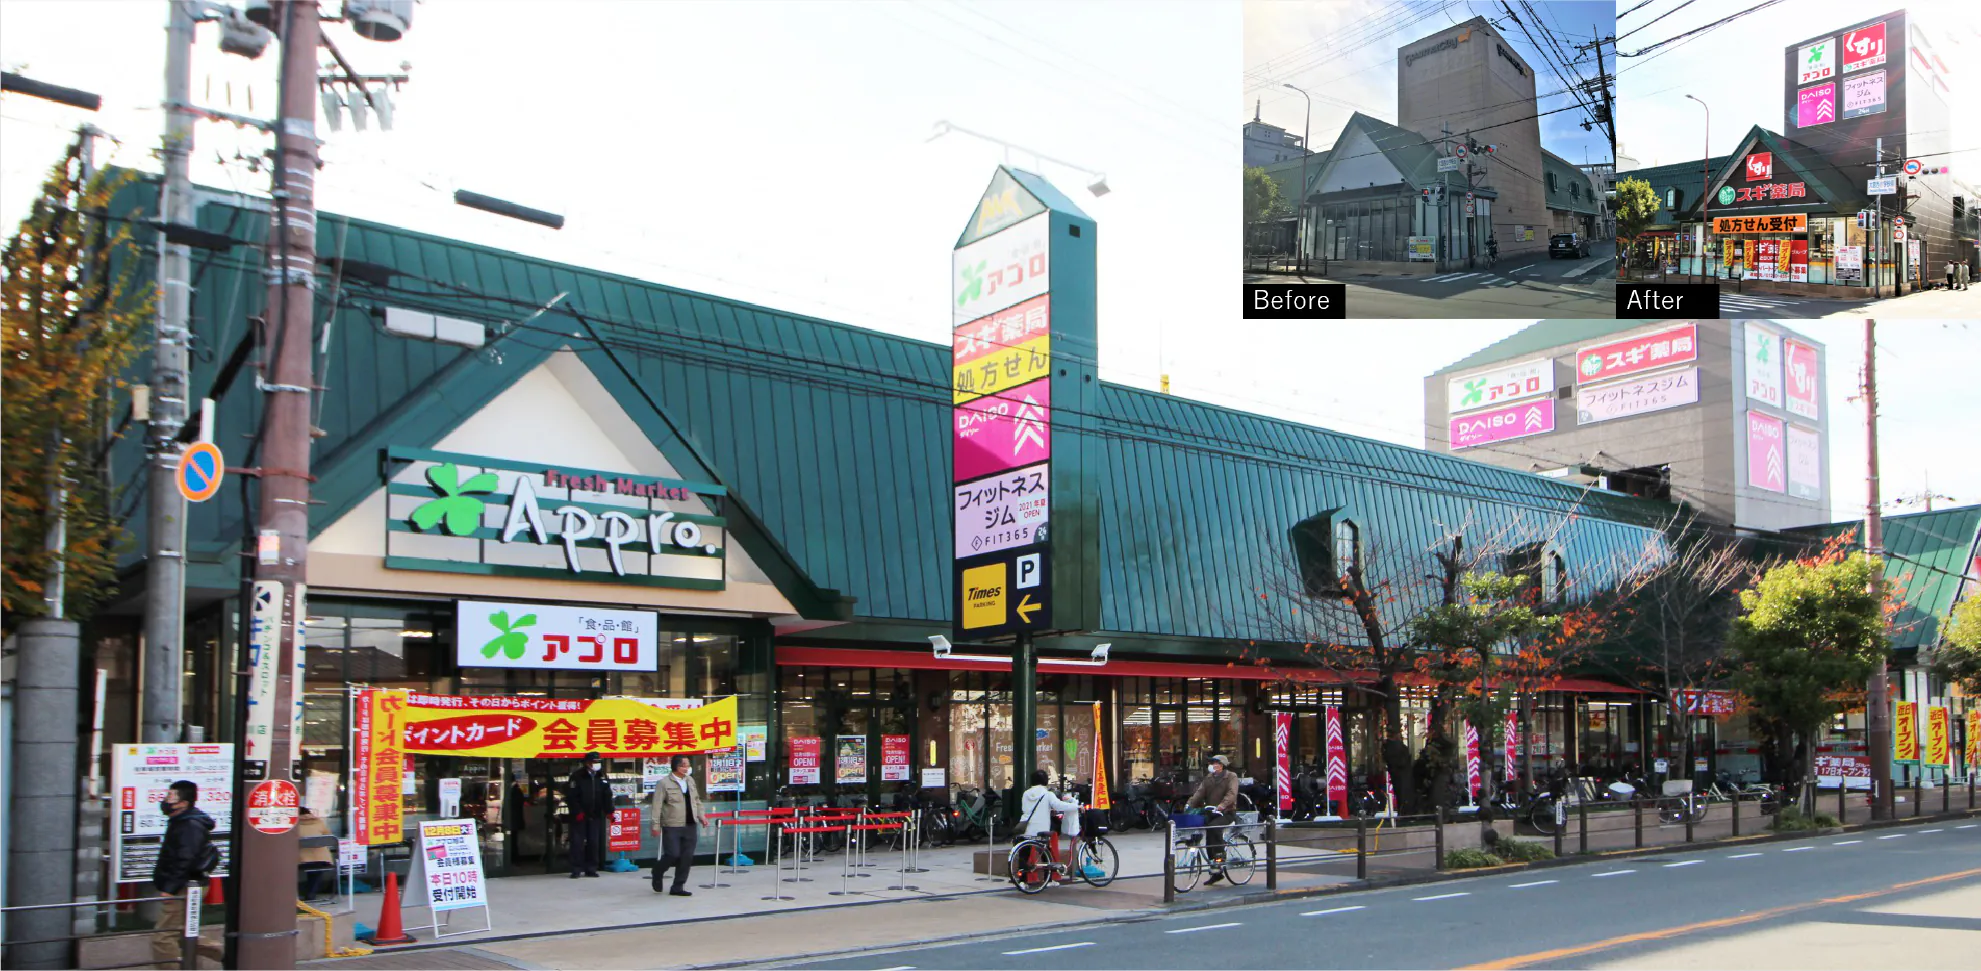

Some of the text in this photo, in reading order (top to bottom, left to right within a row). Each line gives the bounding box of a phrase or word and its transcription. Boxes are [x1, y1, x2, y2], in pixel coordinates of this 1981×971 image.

[1846, 33, 1883, 56] くすり
[1845, 76, 1884, 91] フィットネス
[1856, 89, 1871, 98] ジム
[1801, 88, 1831, 101] DAISO
[1747, 156, 1770, 177] くすり
[1736, 182, 1806, 202] スギ薬局
[1719, 216, 1798, 232] 処方せん受付
[956, 305, 1047, 359] スギ薬局
[1606, 336, 1693, 370] スギ薬局
[957, 346, 1047, 396] 処方せん
[1788, 344, 1816, 403] くすり
[1586, 375, 1688, 405] フィットネスジム
[959, 402, 1009, 428] DAISO
[1459, 413, 1516, 435] DAISO
[1752, 420, 1779, 438] DAISO
[547, 470, 690, 501] Fresh Market
[958, 472, 1045, 511] フィットネス
[985, 505, 1016, 529] ジム
[1023, 509, 1040, 518] OPEN
[985, 530, 1029, 546] FIT365
[1021, 560, 1035, 583] P
[968, 585, 1002, 601] Times
[973, 600, 996, 608] PARKING
[542, 633, 640, 665] アプロ
[542, 716, 732, 751] 会員募集中
[793, 757, 816, 767] OPEN!
[254, 790, 296, 806] 消火栓
[430, 871, 477, 886] 本日10時
[433, 885, 477, 902] 受付開始
